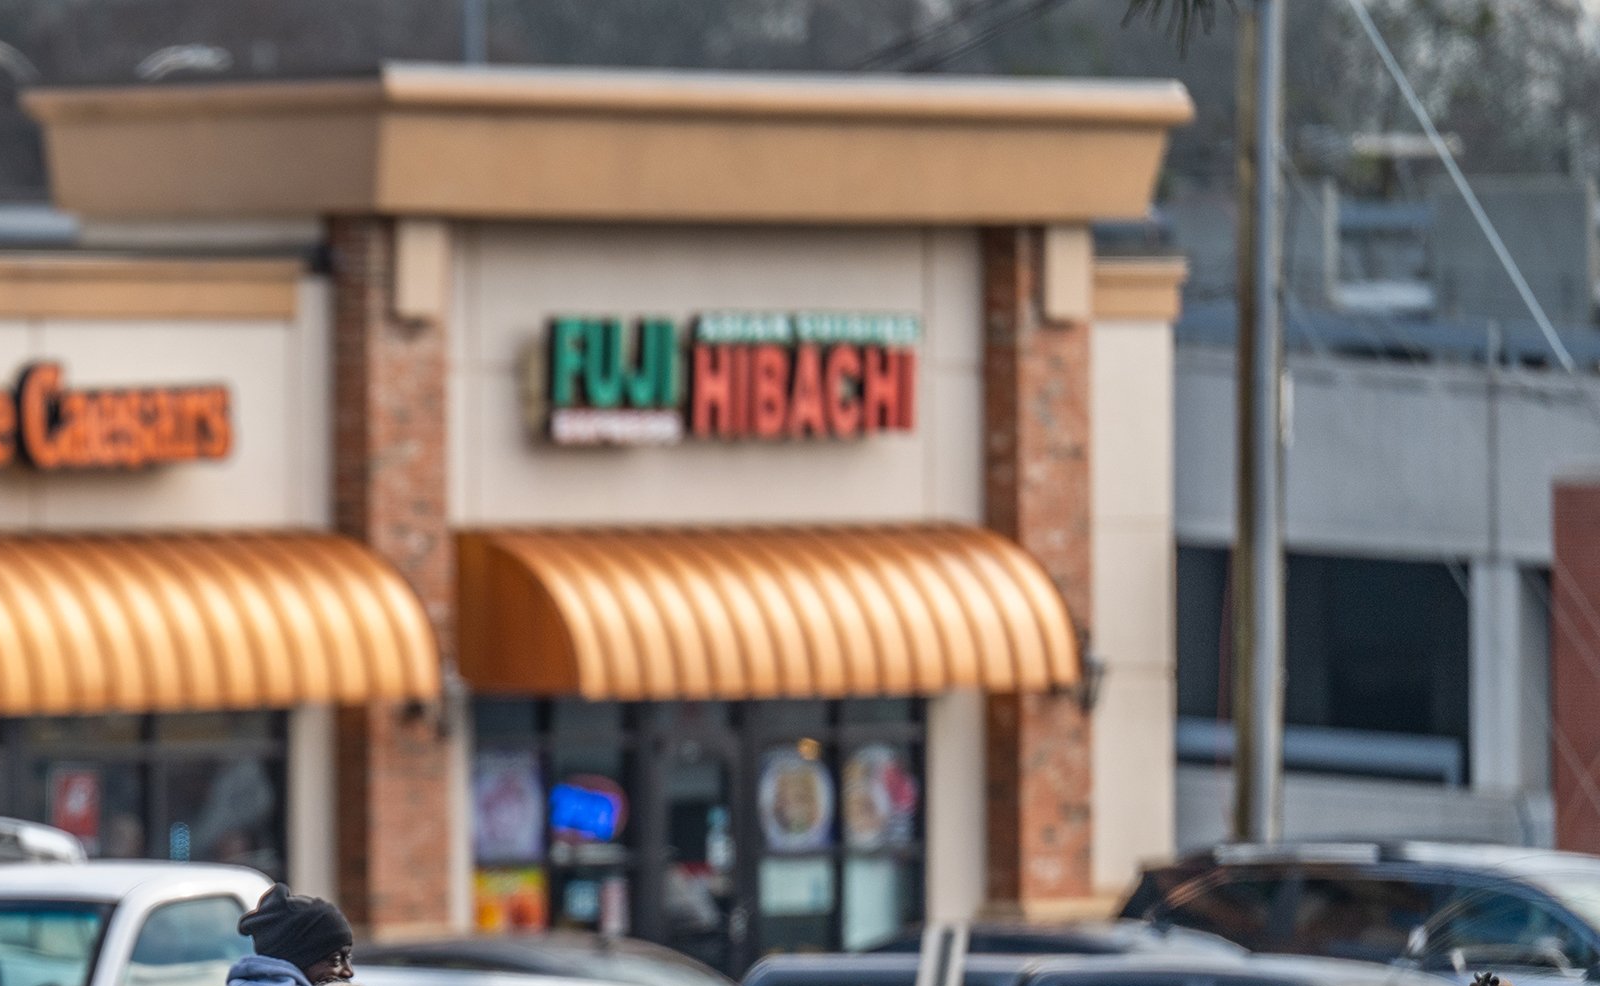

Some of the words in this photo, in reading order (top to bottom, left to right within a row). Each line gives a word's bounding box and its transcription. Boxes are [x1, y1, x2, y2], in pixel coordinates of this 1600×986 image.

[18, 361, 234, 469] Caesars
[551, 315, 677, 409] FUJI
[692, 342, 917, 440] HIBACHI
